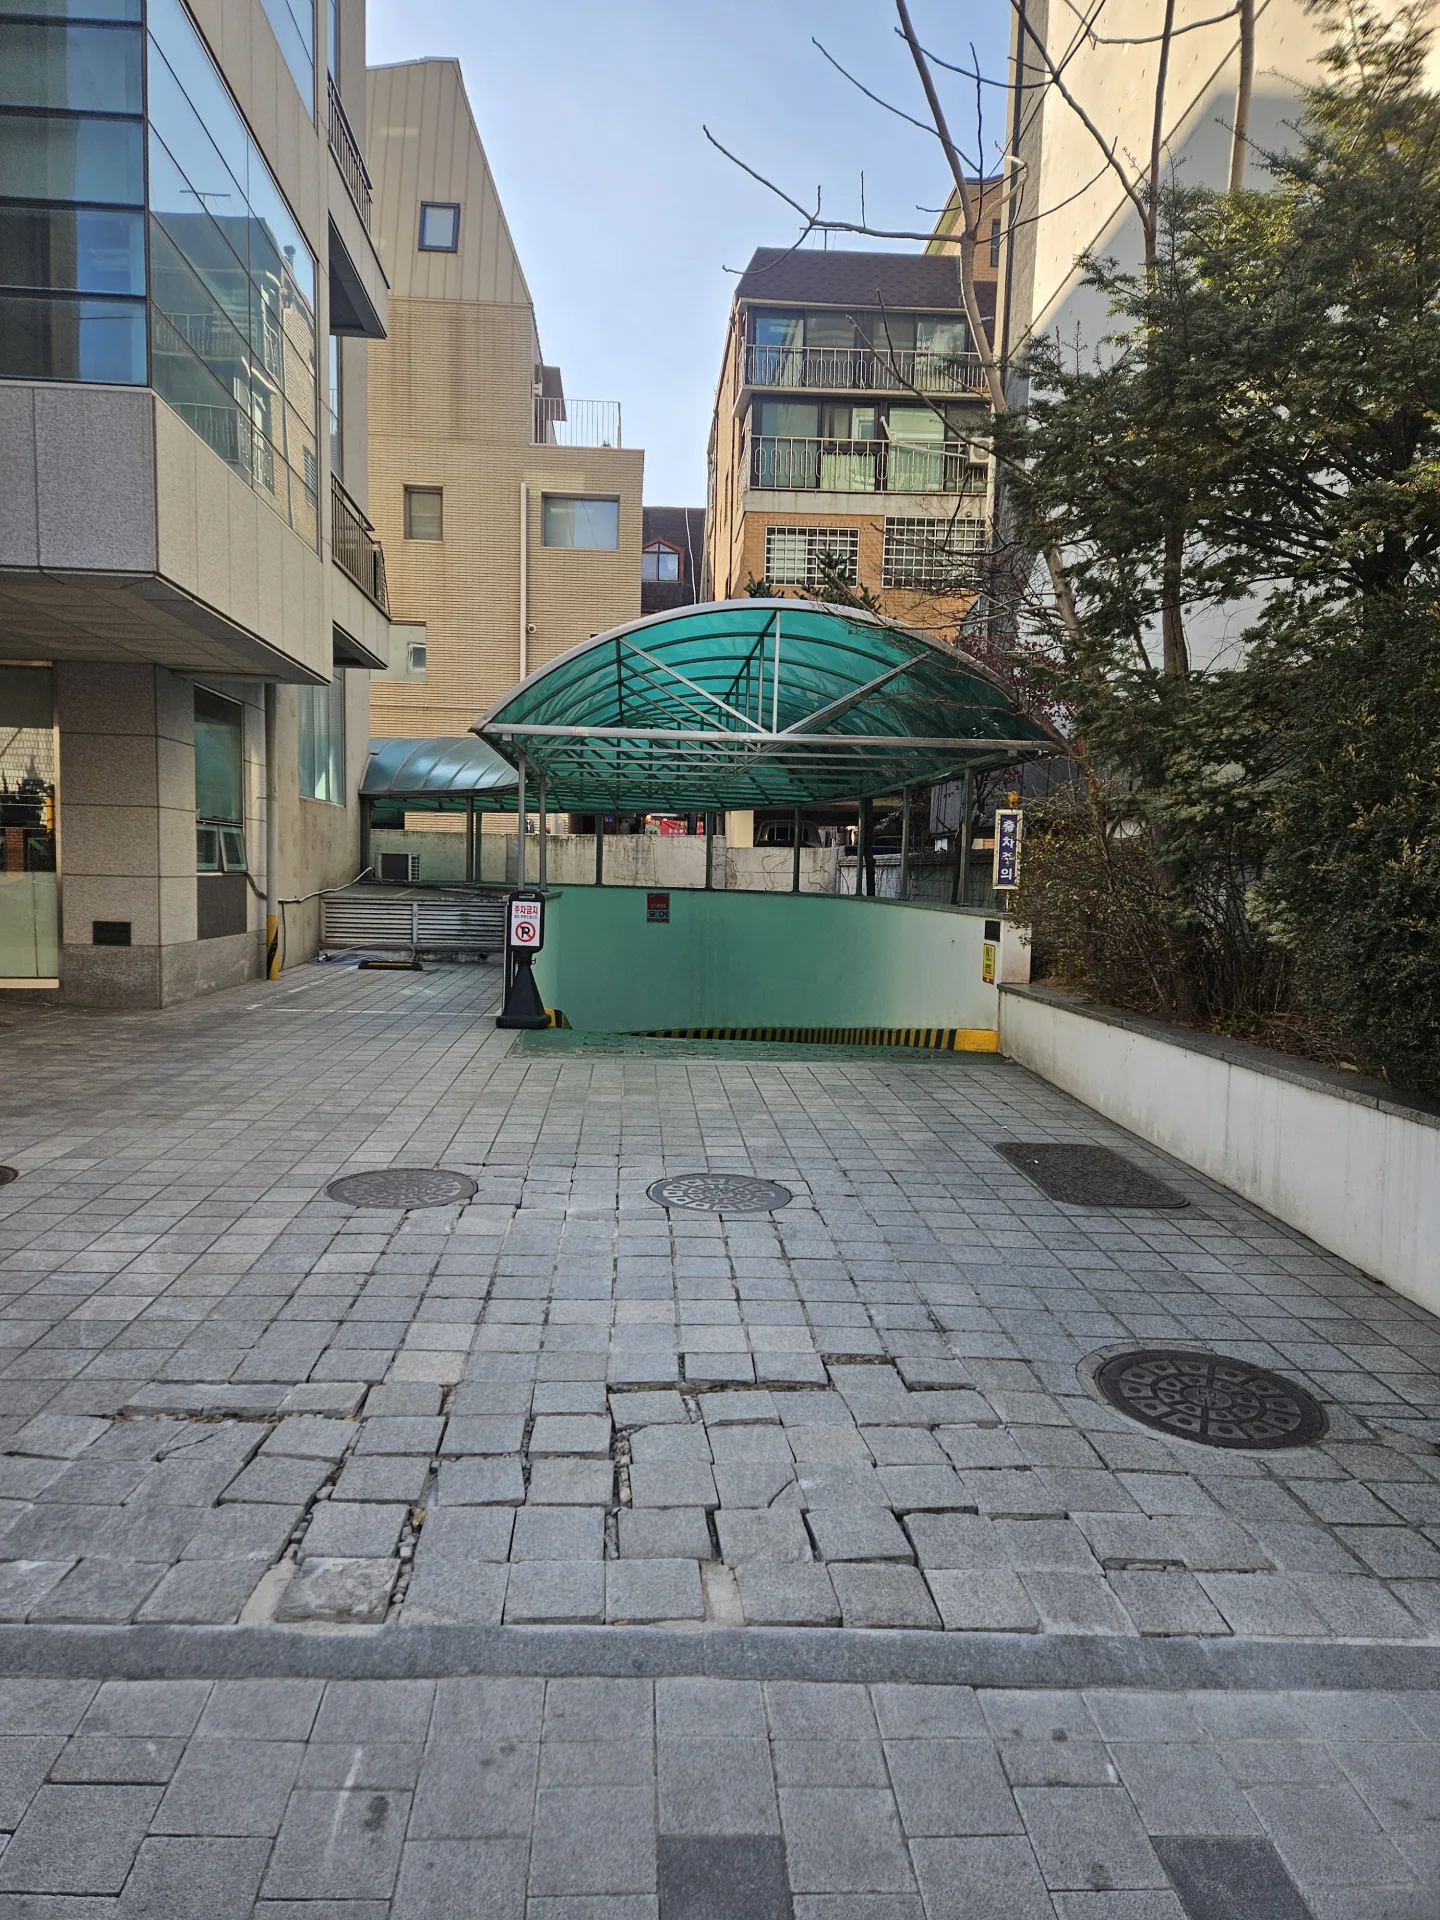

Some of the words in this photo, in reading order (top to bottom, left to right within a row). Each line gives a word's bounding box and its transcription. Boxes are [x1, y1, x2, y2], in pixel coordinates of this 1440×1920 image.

[1000, 819, 1015, 880] 출차주의
[514, 904, 538, 914] 주차금지
[648, 910, 669, 918] SECOM
